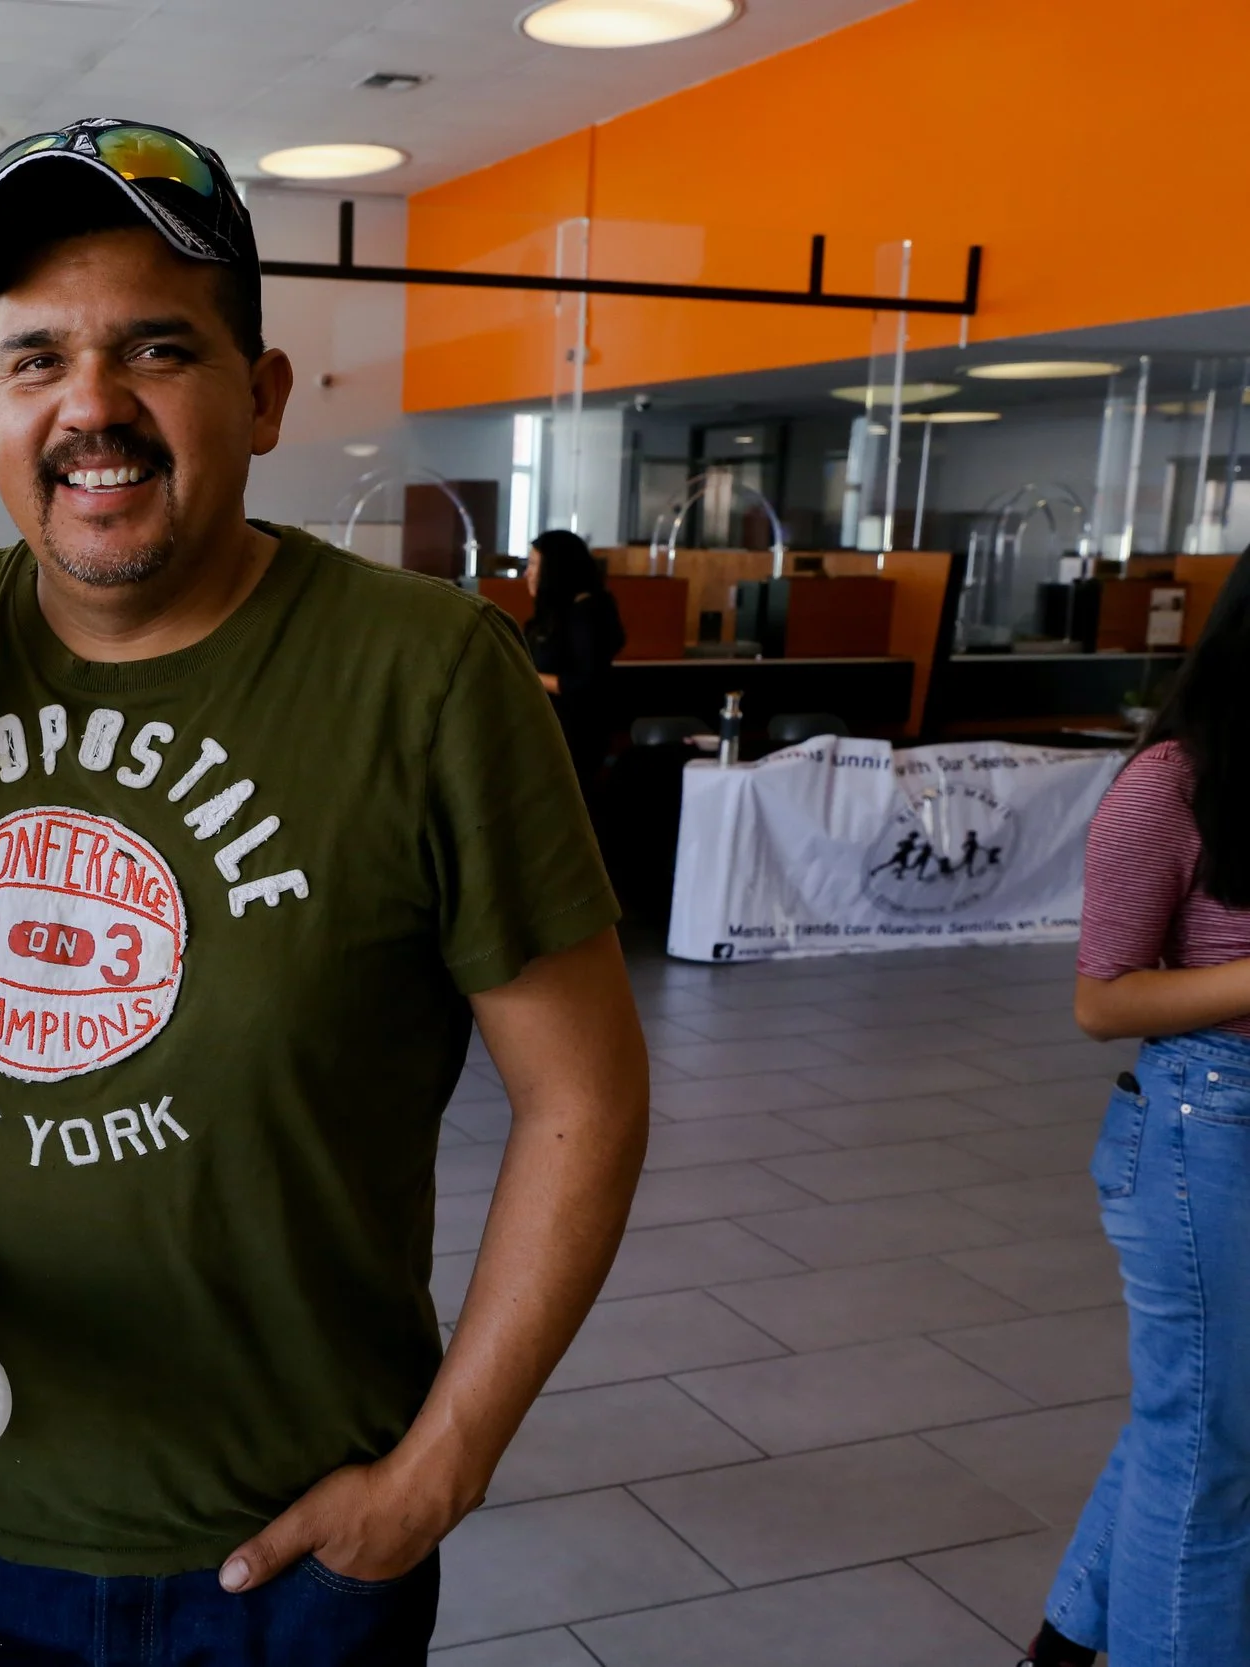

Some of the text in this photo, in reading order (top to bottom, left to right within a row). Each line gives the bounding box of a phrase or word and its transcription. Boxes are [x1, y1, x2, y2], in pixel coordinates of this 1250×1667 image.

[28, 926, 78, 959] ON
[99, 922, 143, 986] 3
[23, 1095, 190, 1167] YORK
